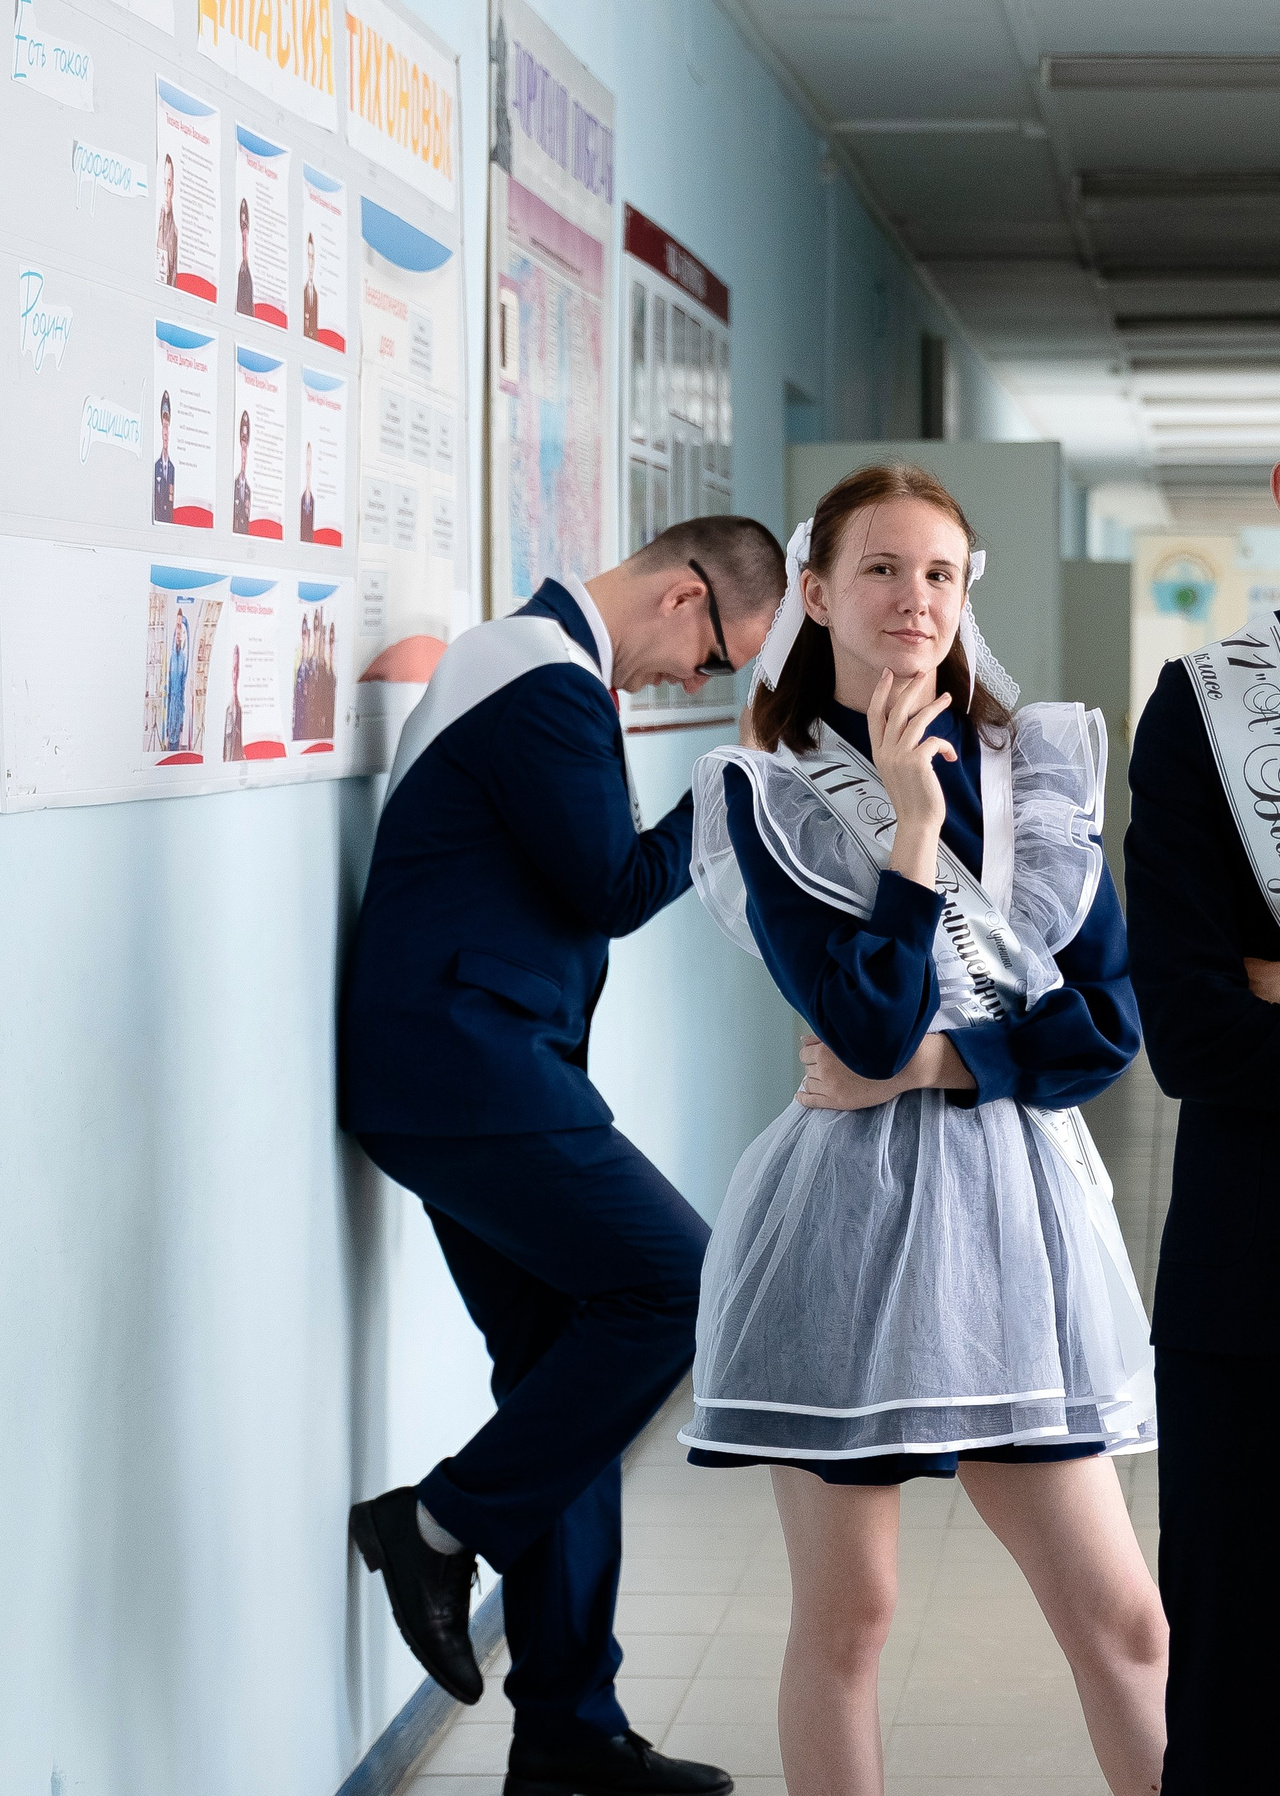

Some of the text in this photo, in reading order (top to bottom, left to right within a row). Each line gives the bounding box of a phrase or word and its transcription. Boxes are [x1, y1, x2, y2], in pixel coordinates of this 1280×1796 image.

[14, 0, 89, 81] Есть такая
[345, 11, 453, 183] ТИХОНОВЫХ
[20, 270, 73, 371] Родину
[1192, 653, 1223, 701] класс
[809, 760, 897, 842] 11"А
